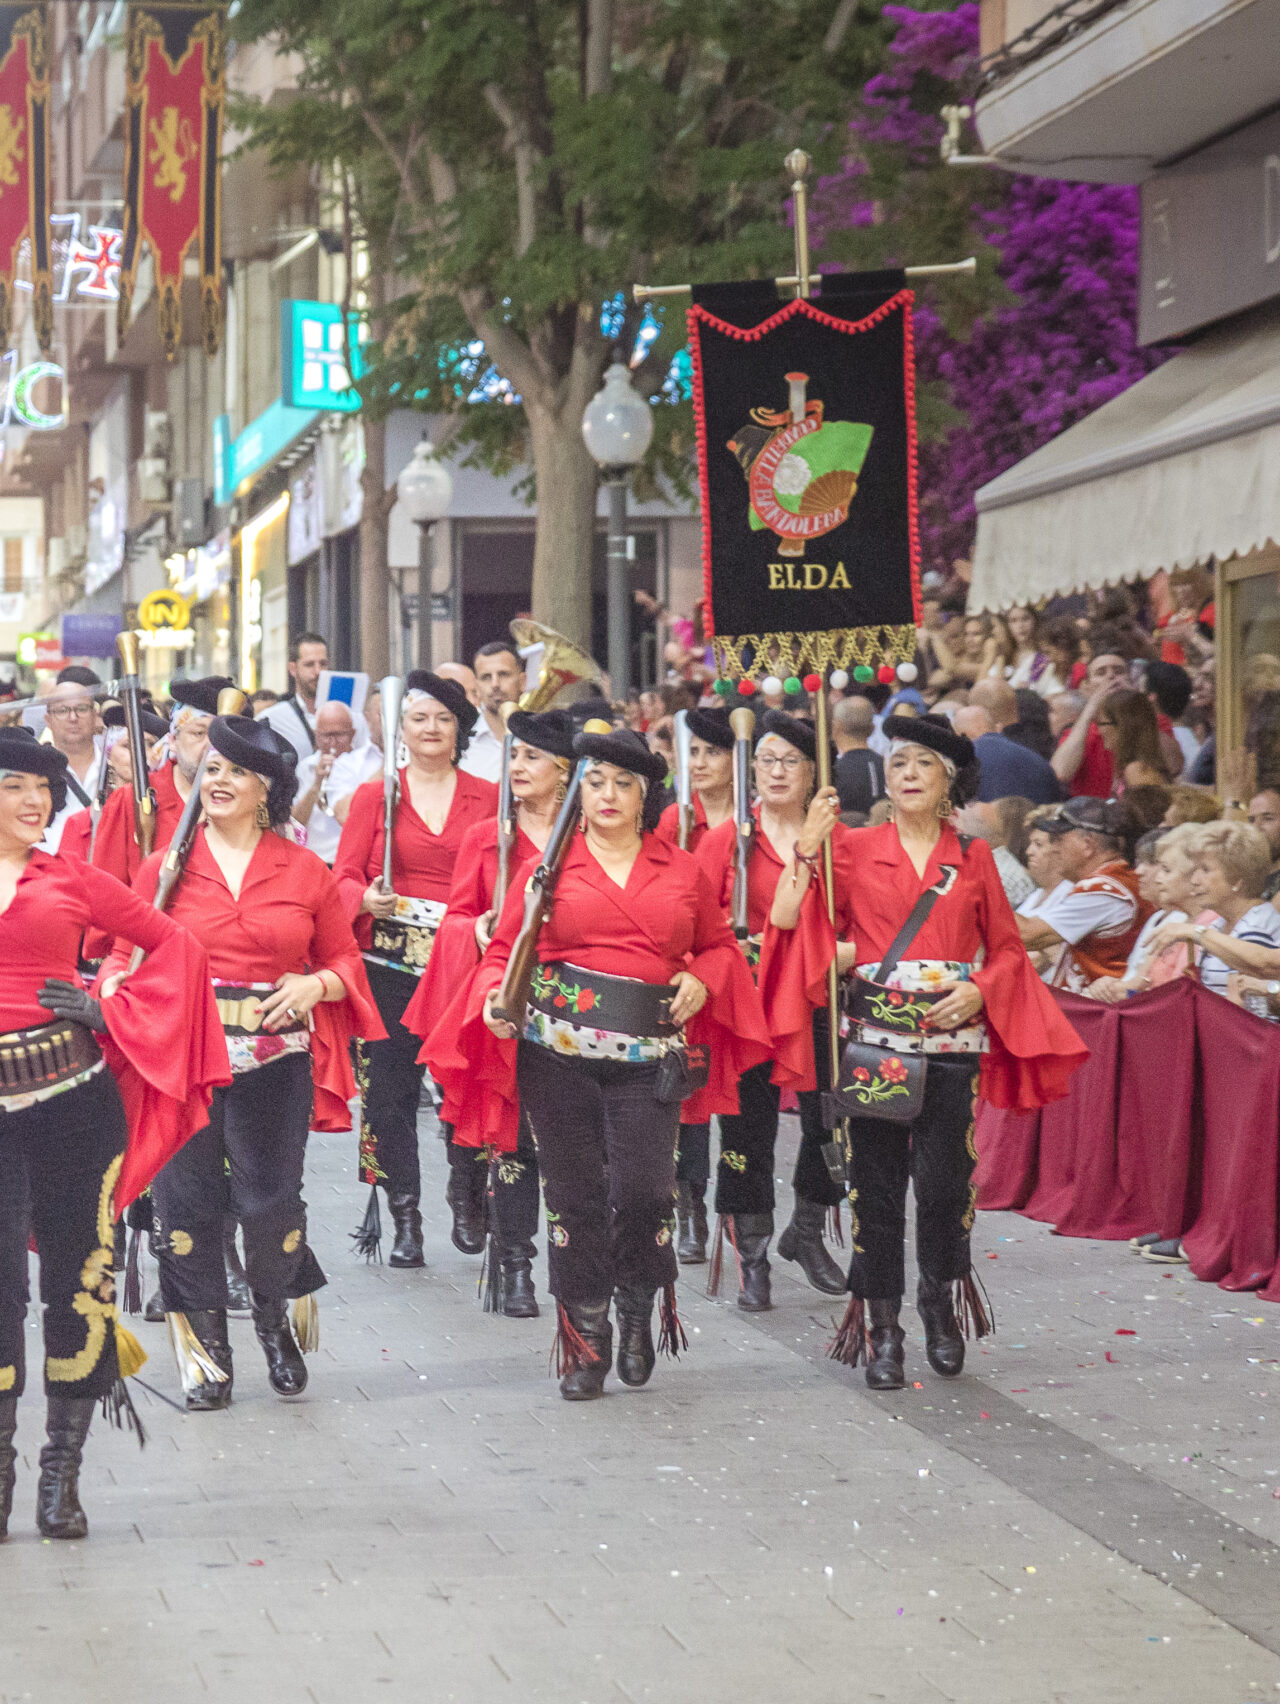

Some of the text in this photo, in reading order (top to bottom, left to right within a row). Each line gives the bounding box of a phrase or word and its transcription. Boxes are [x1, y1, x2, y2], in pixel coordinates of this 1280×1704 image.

[754, 488, 846, 535] BANDOLERA
[767, 561, 853, 590] ELDA
[148, 602, 180, 624] IN
